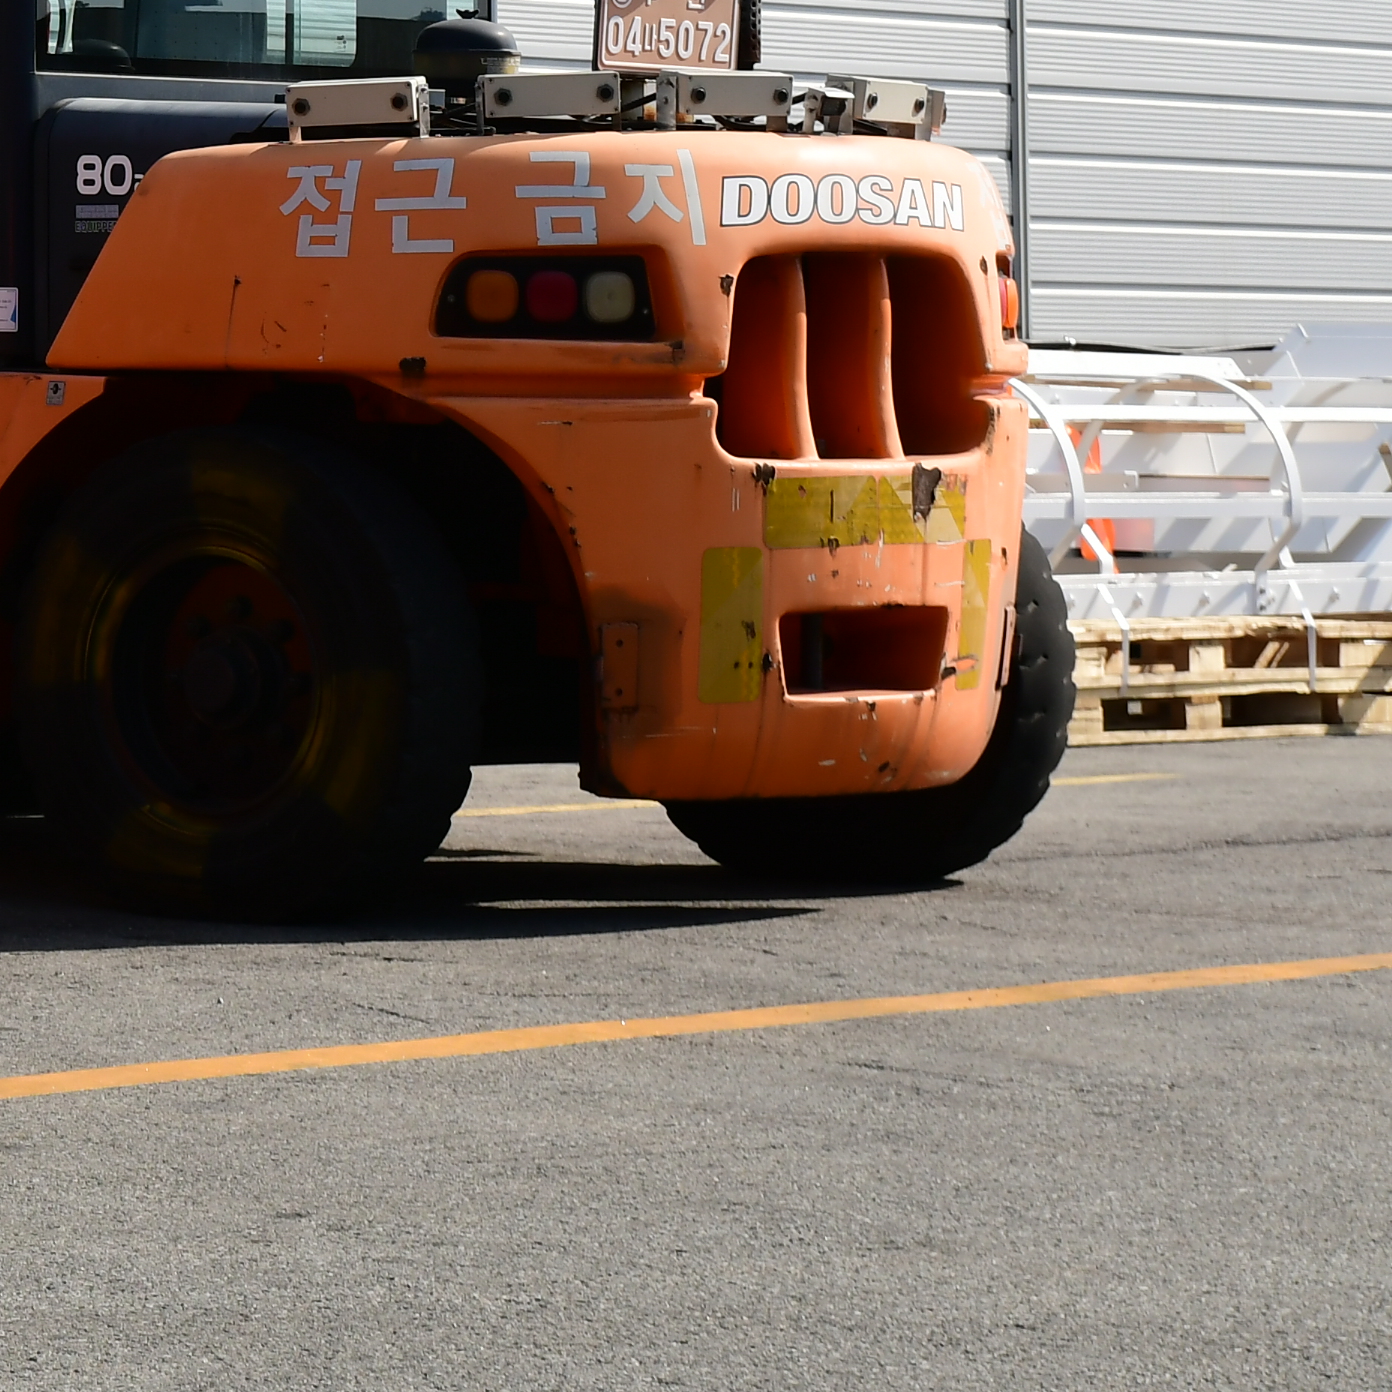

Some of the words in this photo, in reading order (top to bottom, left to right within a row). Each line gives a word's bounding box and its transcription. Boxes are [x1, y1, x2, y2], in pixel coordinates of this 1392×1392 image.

[607, 15, 731, 62] 04나5072
[74, 219, 117, 234] EQUIPPE
[278, 156, 467, 258] 접근
[515, 149, 707, 246] 금지
[720, 172, 965, 232] DOOSAN
